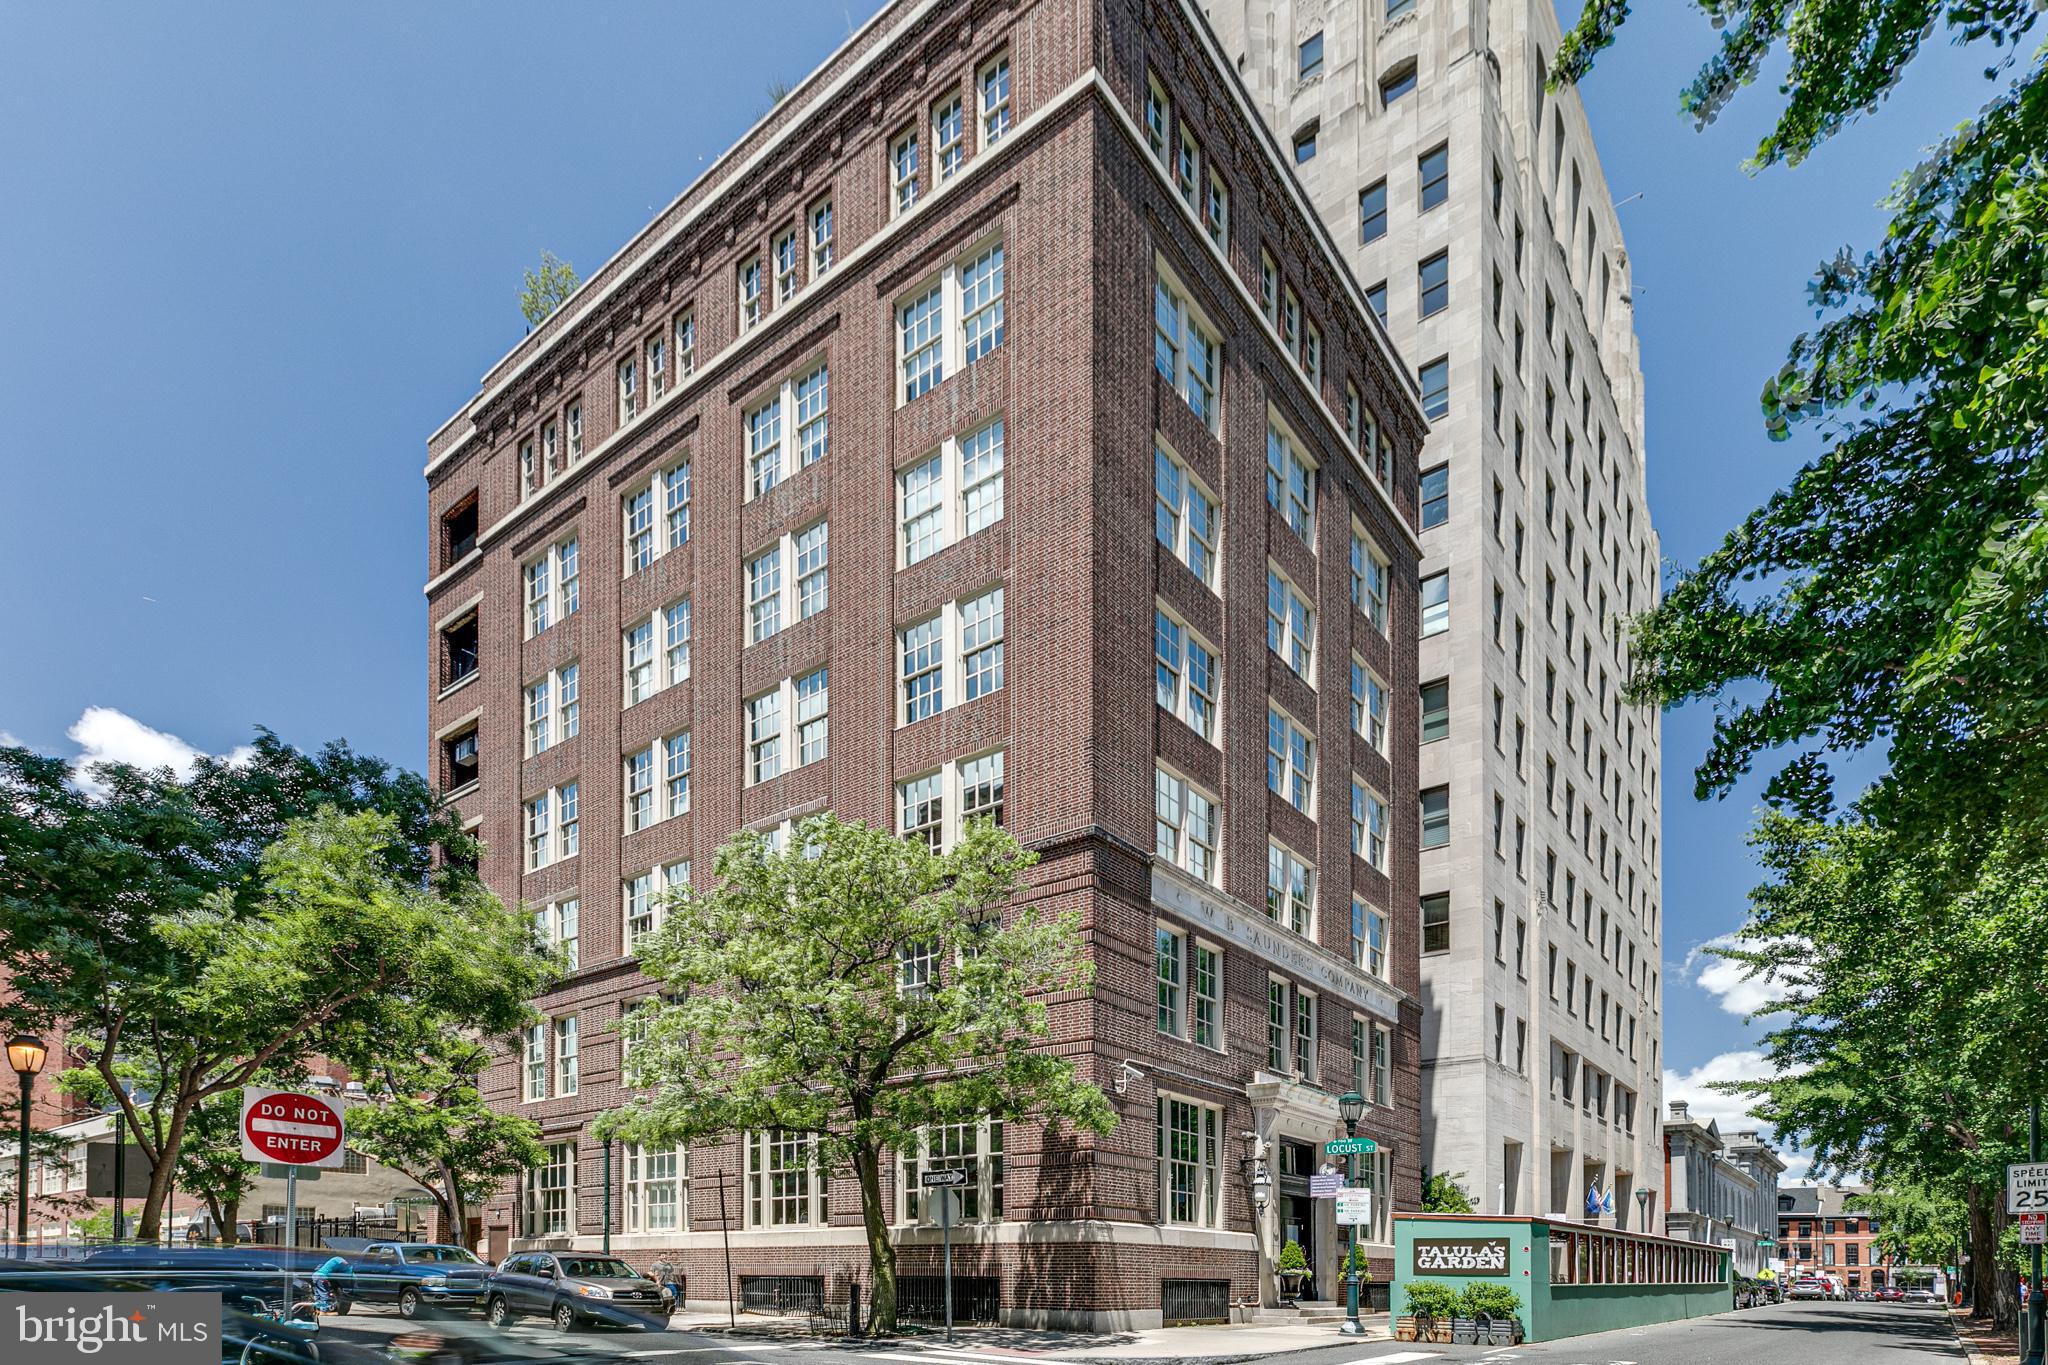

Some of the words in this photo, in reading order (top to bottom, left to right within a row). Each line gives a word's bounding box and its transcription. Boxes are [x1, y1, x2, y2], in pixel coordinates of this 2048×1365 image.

[1246, 927, 1313, 972] SAUNDERS
[1320, 966, 1369, 1001] COMPANY
[261, 1104, 285, 1117] DO
[294, 1107, 329, 1122] NOT
[266, 1136, 321, 1152] ENTER
[1326, 1143, 1362, 1154] LOCUST
[940, 1173, 952, 1181] WAY
[2013, 1167, 2048, 1178] SPEED
[2016, 1178, 2048, 1188] LIMIT
[2016, 1190, 2048, 1207] 25
[1417, 1256, 1505, 1269] GARDEN
